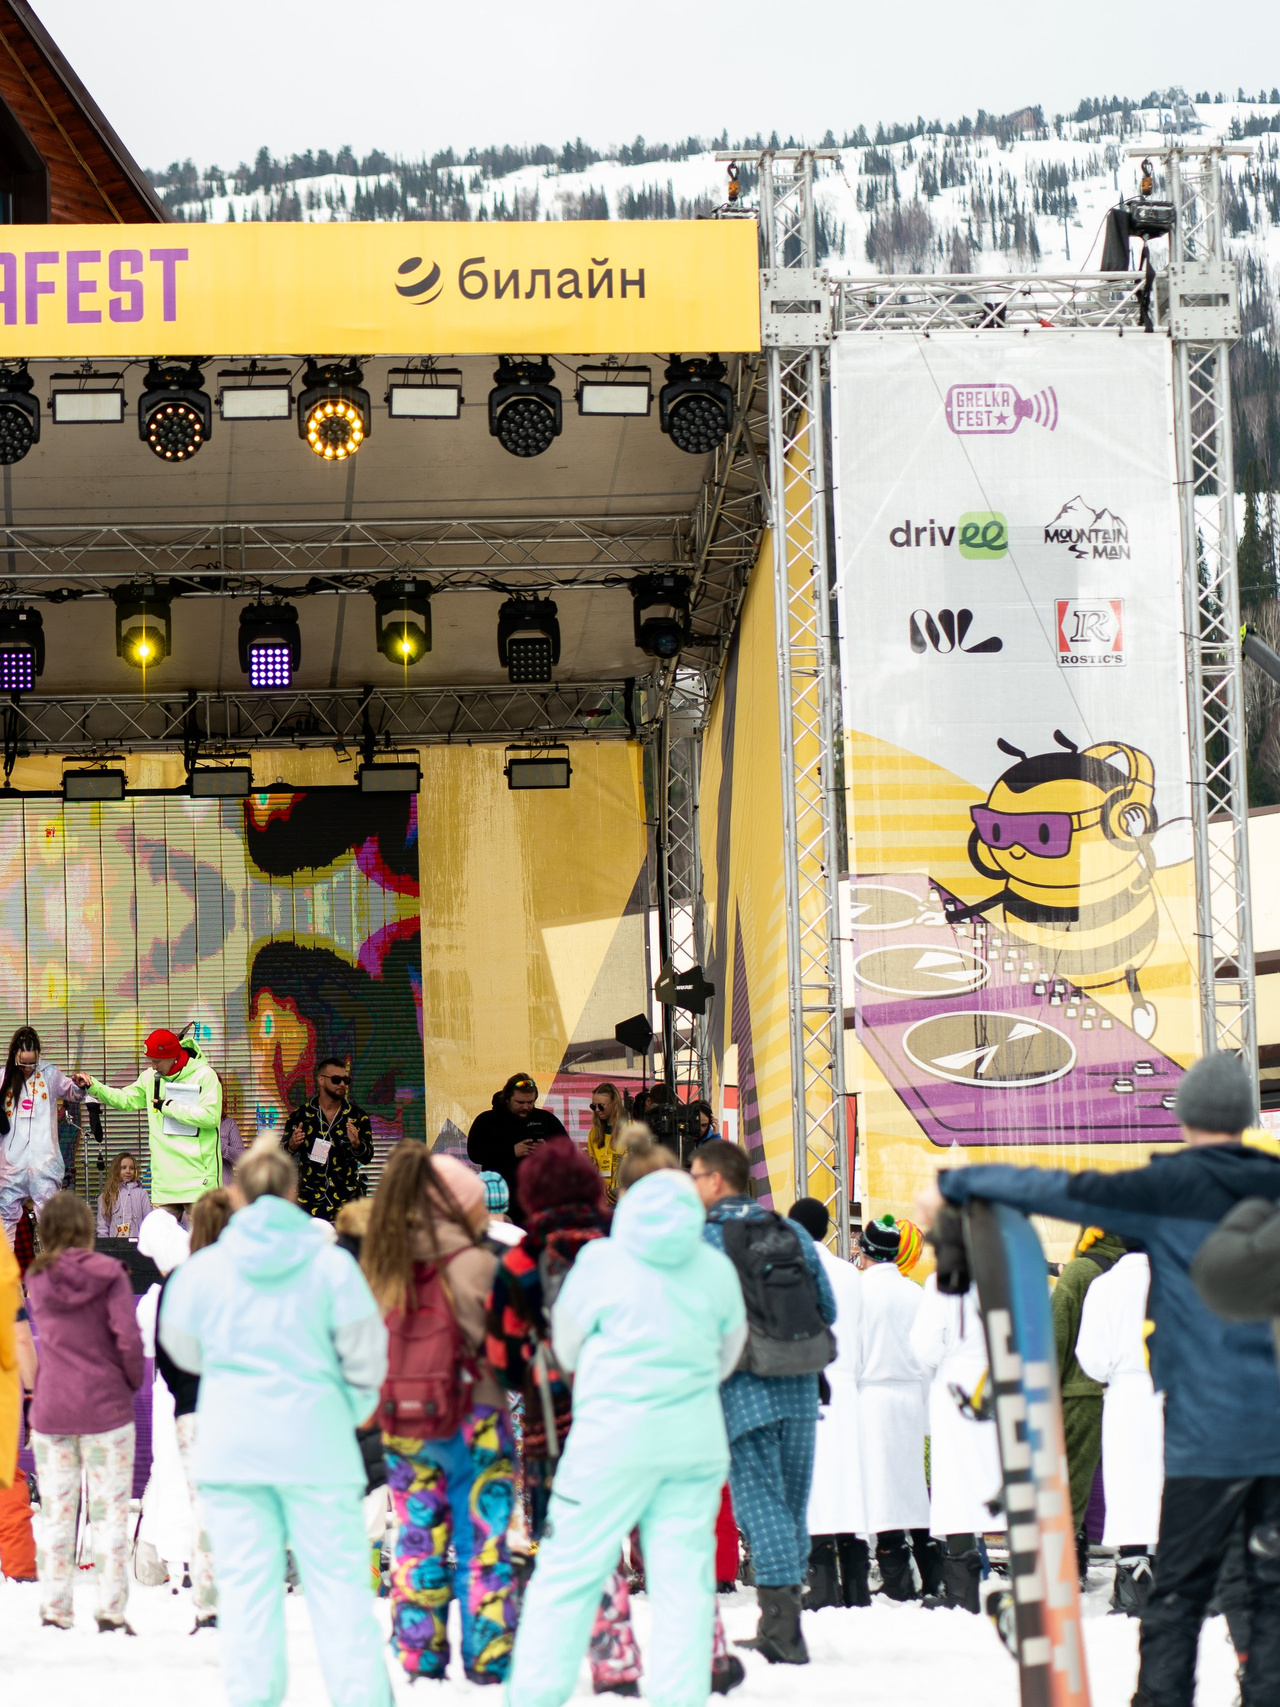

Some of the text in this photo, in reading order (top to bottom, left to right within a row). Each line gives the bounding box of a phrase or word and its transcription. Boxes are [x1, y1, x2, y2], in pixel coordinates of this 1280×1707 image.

[458, 256, 647, 301] билайн
[956, 391, 1010, 408] GRELKA
[957, 410, 993, 427] FEST
[889, 519, 1008, 551] drivee
[1044, 528, 1128, 544] MOUNTAIN
[1093, 545, 1131, 560] MAN
[1060, 654, 1123, 664] ROSTIC'S
